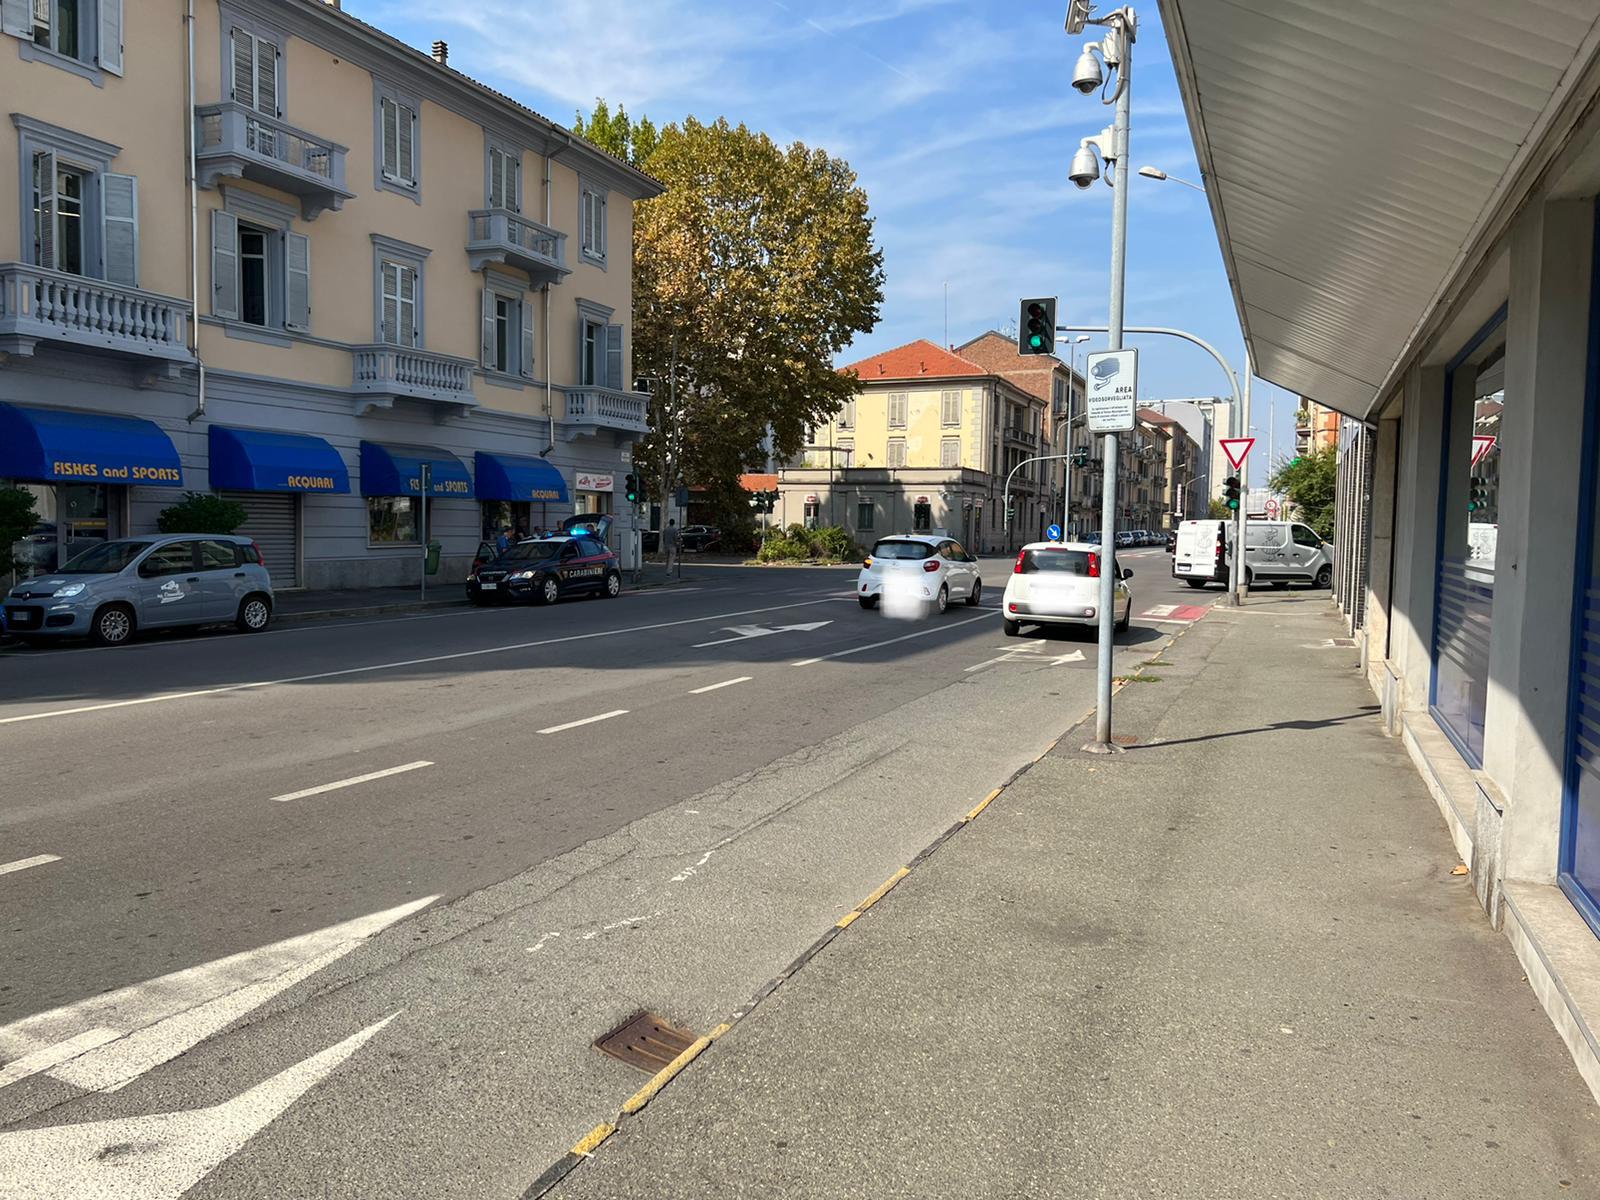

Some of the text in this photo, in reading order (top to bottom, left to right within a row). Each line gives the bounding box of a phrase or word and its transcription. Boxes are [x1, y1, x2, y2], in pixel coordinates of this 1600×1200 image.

[54, 462, 180, 480] FISHES and SPORTS
[288, 475, 334, 489] ACQUARI
[433, 483, 444, 491] and
[445, 480, 468, 493] SPORTS
[569, 567, 603, 578] CARABINIERI
